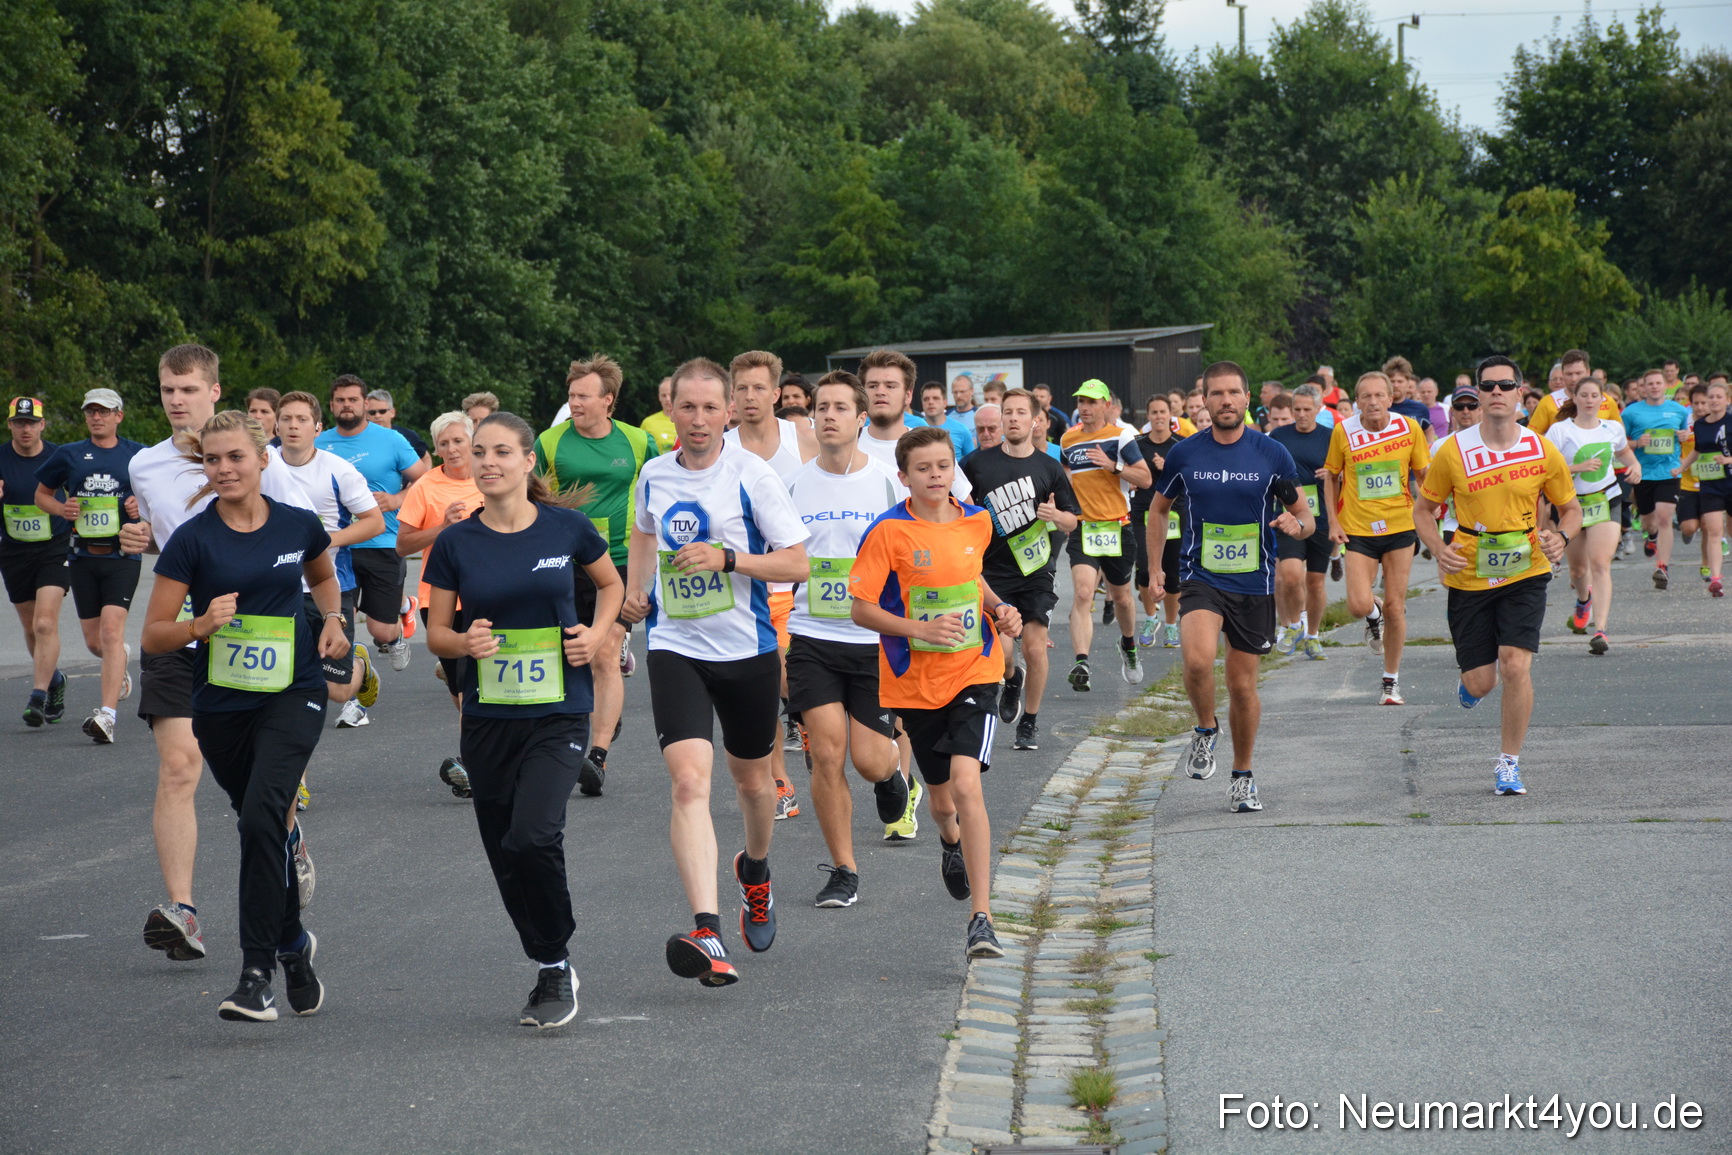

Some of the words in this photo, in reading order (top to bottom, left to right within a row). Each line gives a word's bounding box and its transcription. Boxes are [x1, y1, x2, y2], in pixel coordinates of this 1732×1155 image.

[1352, 448, 1381, 463] MAX
[1384, 438, 1414, 453] BÖGL
[1193, 471, 1220, 480] EURO
[1230, 472, 1259, 481] POLES
[1365, 474, 1393, 489] 904
[1468, 473, 1504, 493] MAX
[1509, 464, 1547, 481] BÖGL
[987, 475, 1036, 514] MDN
[83, 512, 109, 527] 180
[800, 510, 875, 525] DELPHI
[997, 499, 1037, 535] DRV
[13, 519, 41, 532] 708
[671, 519, 697, 532] TÜV
[677, 535, 690, 543] SÜD
[1087, 534, 1117, 546] 1634
[1023, 536, 1047, 560] 976
[1213, 544, 1249, 560] 364
[1487, 551, 1522, 567] 873
[667, 571, 724, 599] 1594
[820, 582, 855, 602] 29
[226, 643, 277, 671] 750
[493, 658, 546, 684] 715
